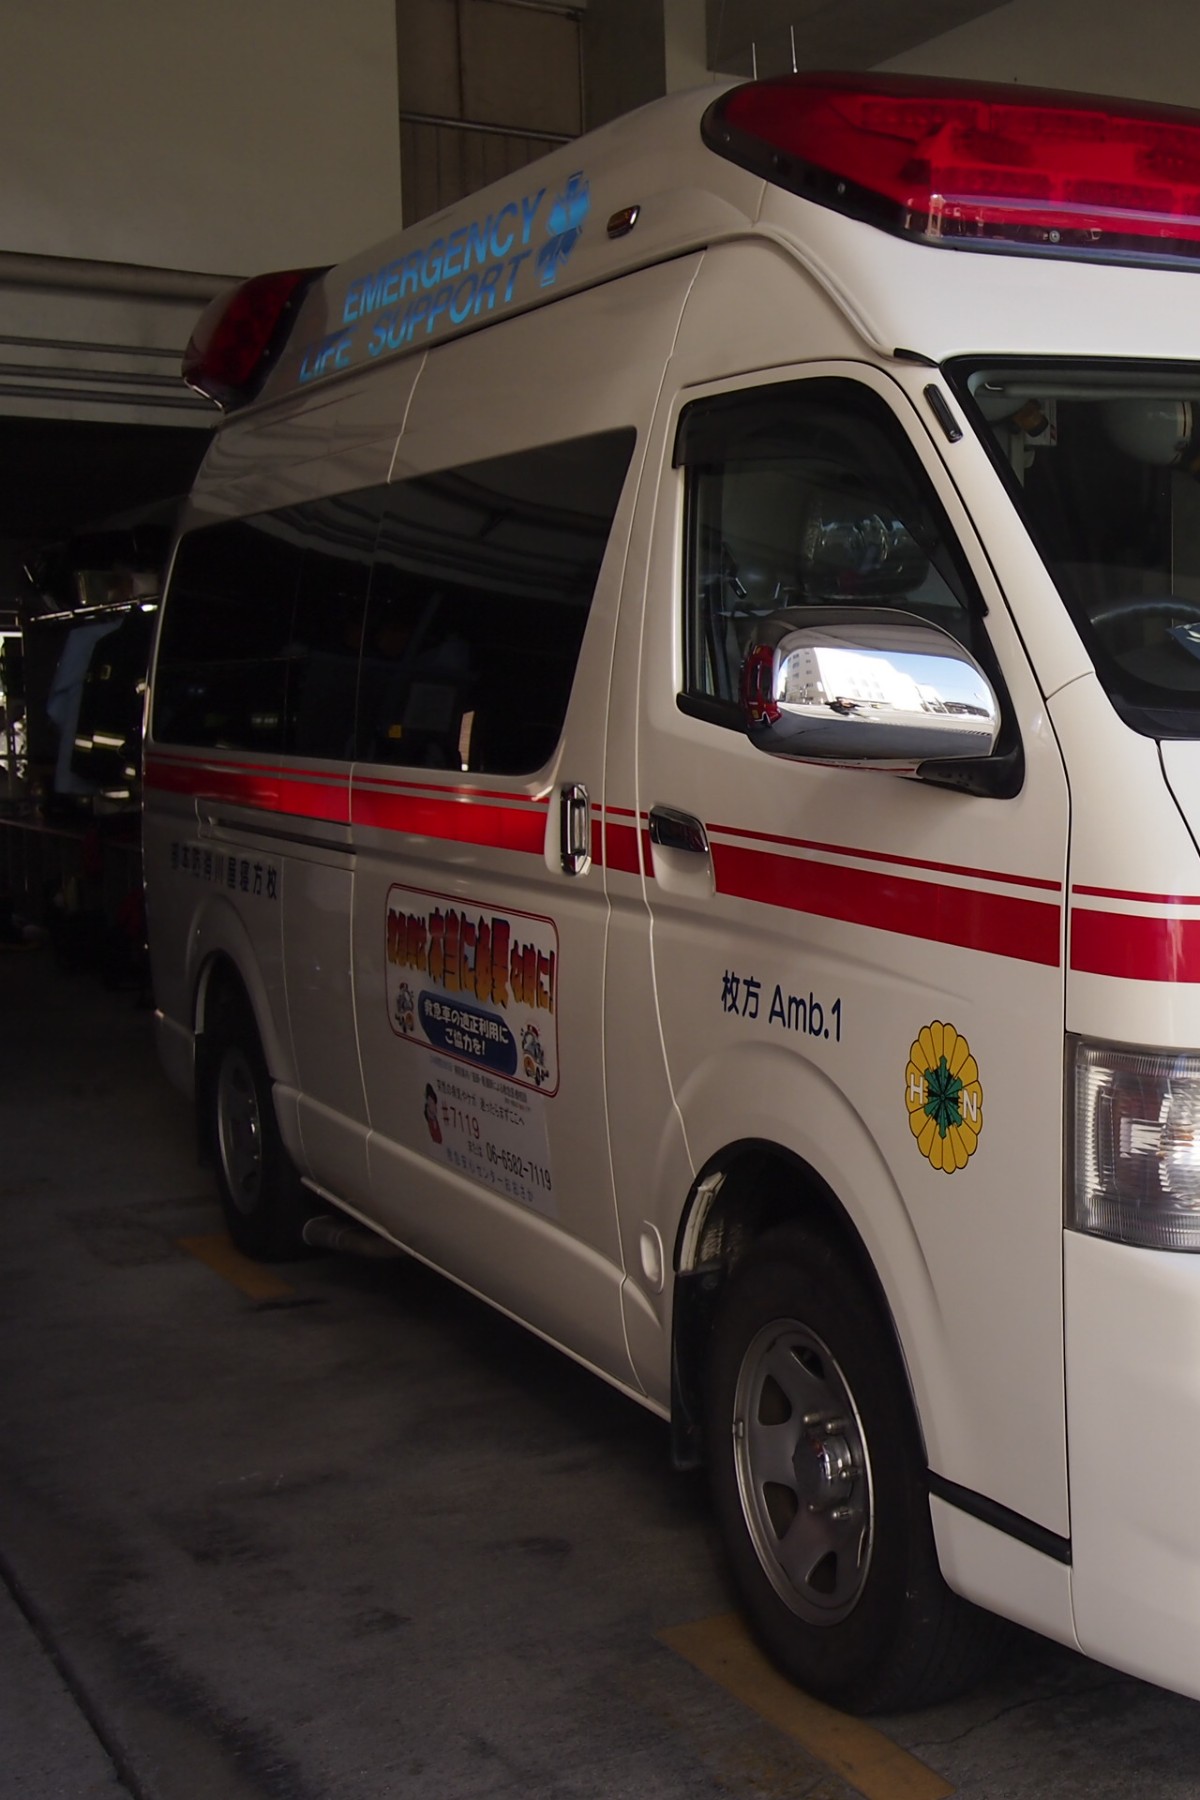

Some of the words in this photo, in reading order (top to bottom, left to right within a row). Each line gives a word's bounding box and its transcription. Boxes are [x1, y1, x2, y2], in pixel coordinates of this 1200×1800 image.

[343, 188, 546, 323] EMERGENCY
[299, 327, 358, 383] LIFE
[368, 249, 532, 358] SUPPORT
[424, 998, 509, 1044] 救急車の適正利用に
[721, 969, 761, 1019] 枚方
[769, 984, 842, 1042] Amb.1
[444, 1027, 486, 1056] ご協力を!
[441, 1103, 480, 1140] #7119
[909, 1073, 923, 1104] H
[962, 1090, 977, 1122] N
[485, 1142, 552, 1191] 06-6582-7119
